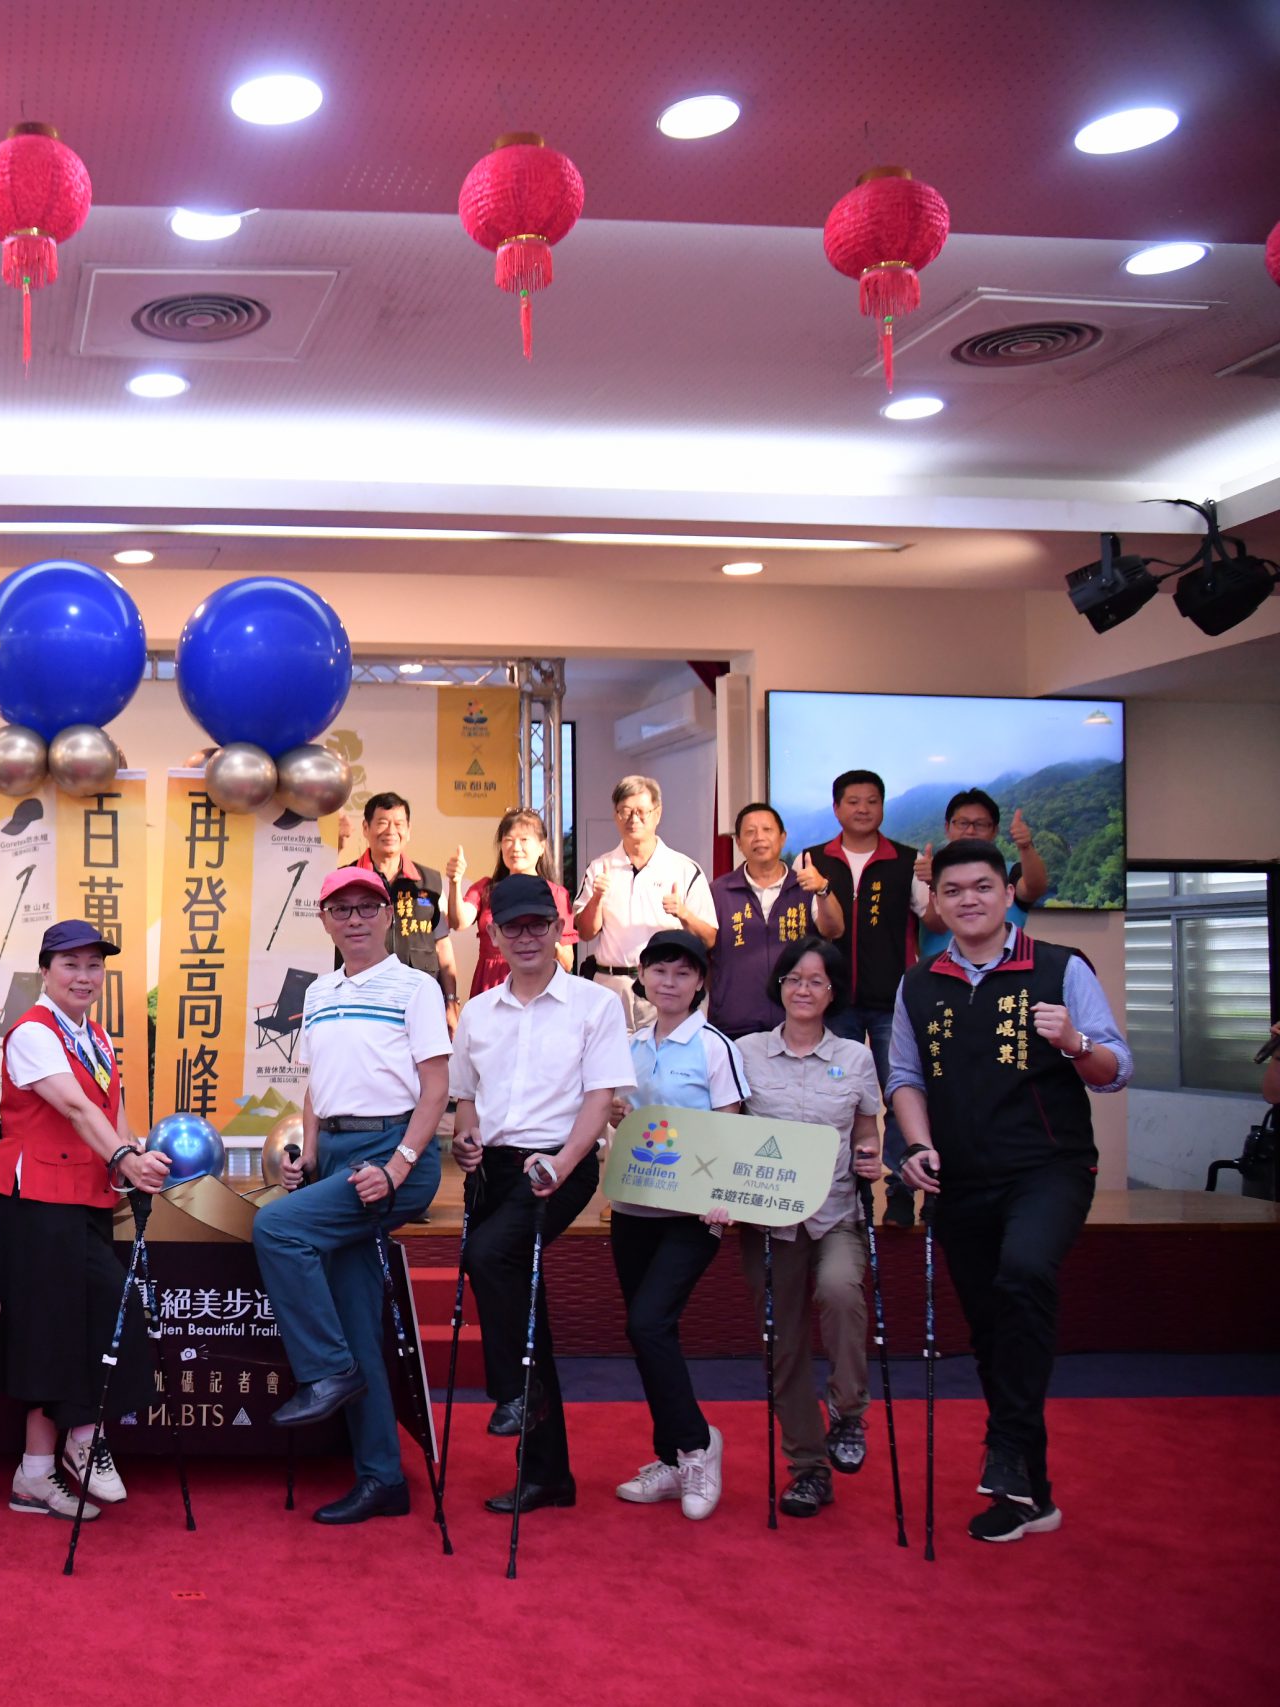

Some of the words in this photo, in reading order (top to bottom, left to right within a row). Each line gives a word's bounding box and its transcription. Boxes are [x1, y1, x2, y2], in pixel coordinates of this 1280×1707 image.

[79, 792, 125, 1112] 百萬加
[175, 791, 230, 1118] 再登高峰
[627, 1163, 677, 1180] Hualien
[732, 1161, 798, 1184] 歐都納
[744, 1180, 780, 1192] ATUNAS
[710, 1187, 806, 1214] 森遊花蓮小百岳
[188, 1322, 245, 1337] Beautiful
